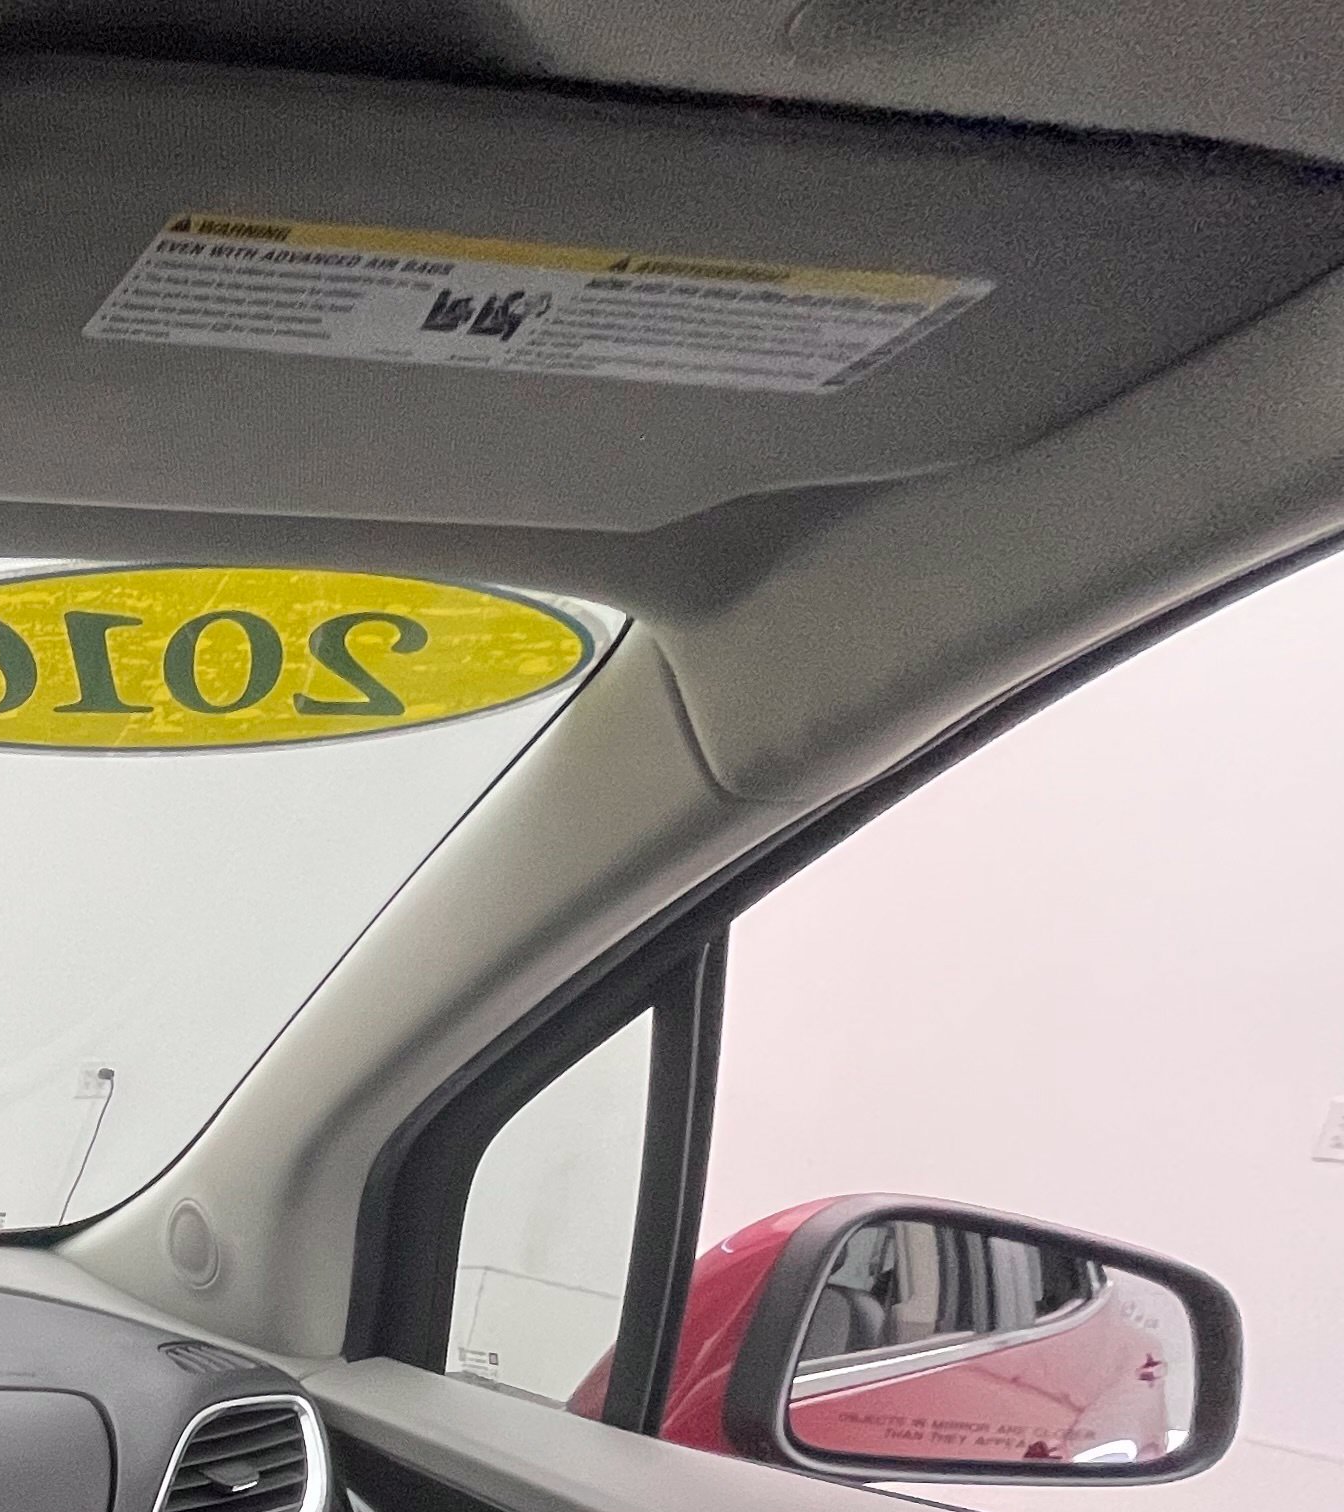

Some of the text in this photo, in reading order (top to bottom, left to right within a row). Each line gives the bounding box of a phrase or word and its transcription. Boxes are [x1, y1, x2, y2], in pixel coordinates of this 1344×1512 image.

[198, 218, 292, 242] WARNING
[155, 238, 208, 256] EVEN
[208, 243, 259, 261] WITH
[261, 248, 362, 268] ADVANCED
[931, 1419, 992, 1433] MIRROR
[884, 1428, 924, 1441] THAN
[929, 1431, 968, 1445] THEY
